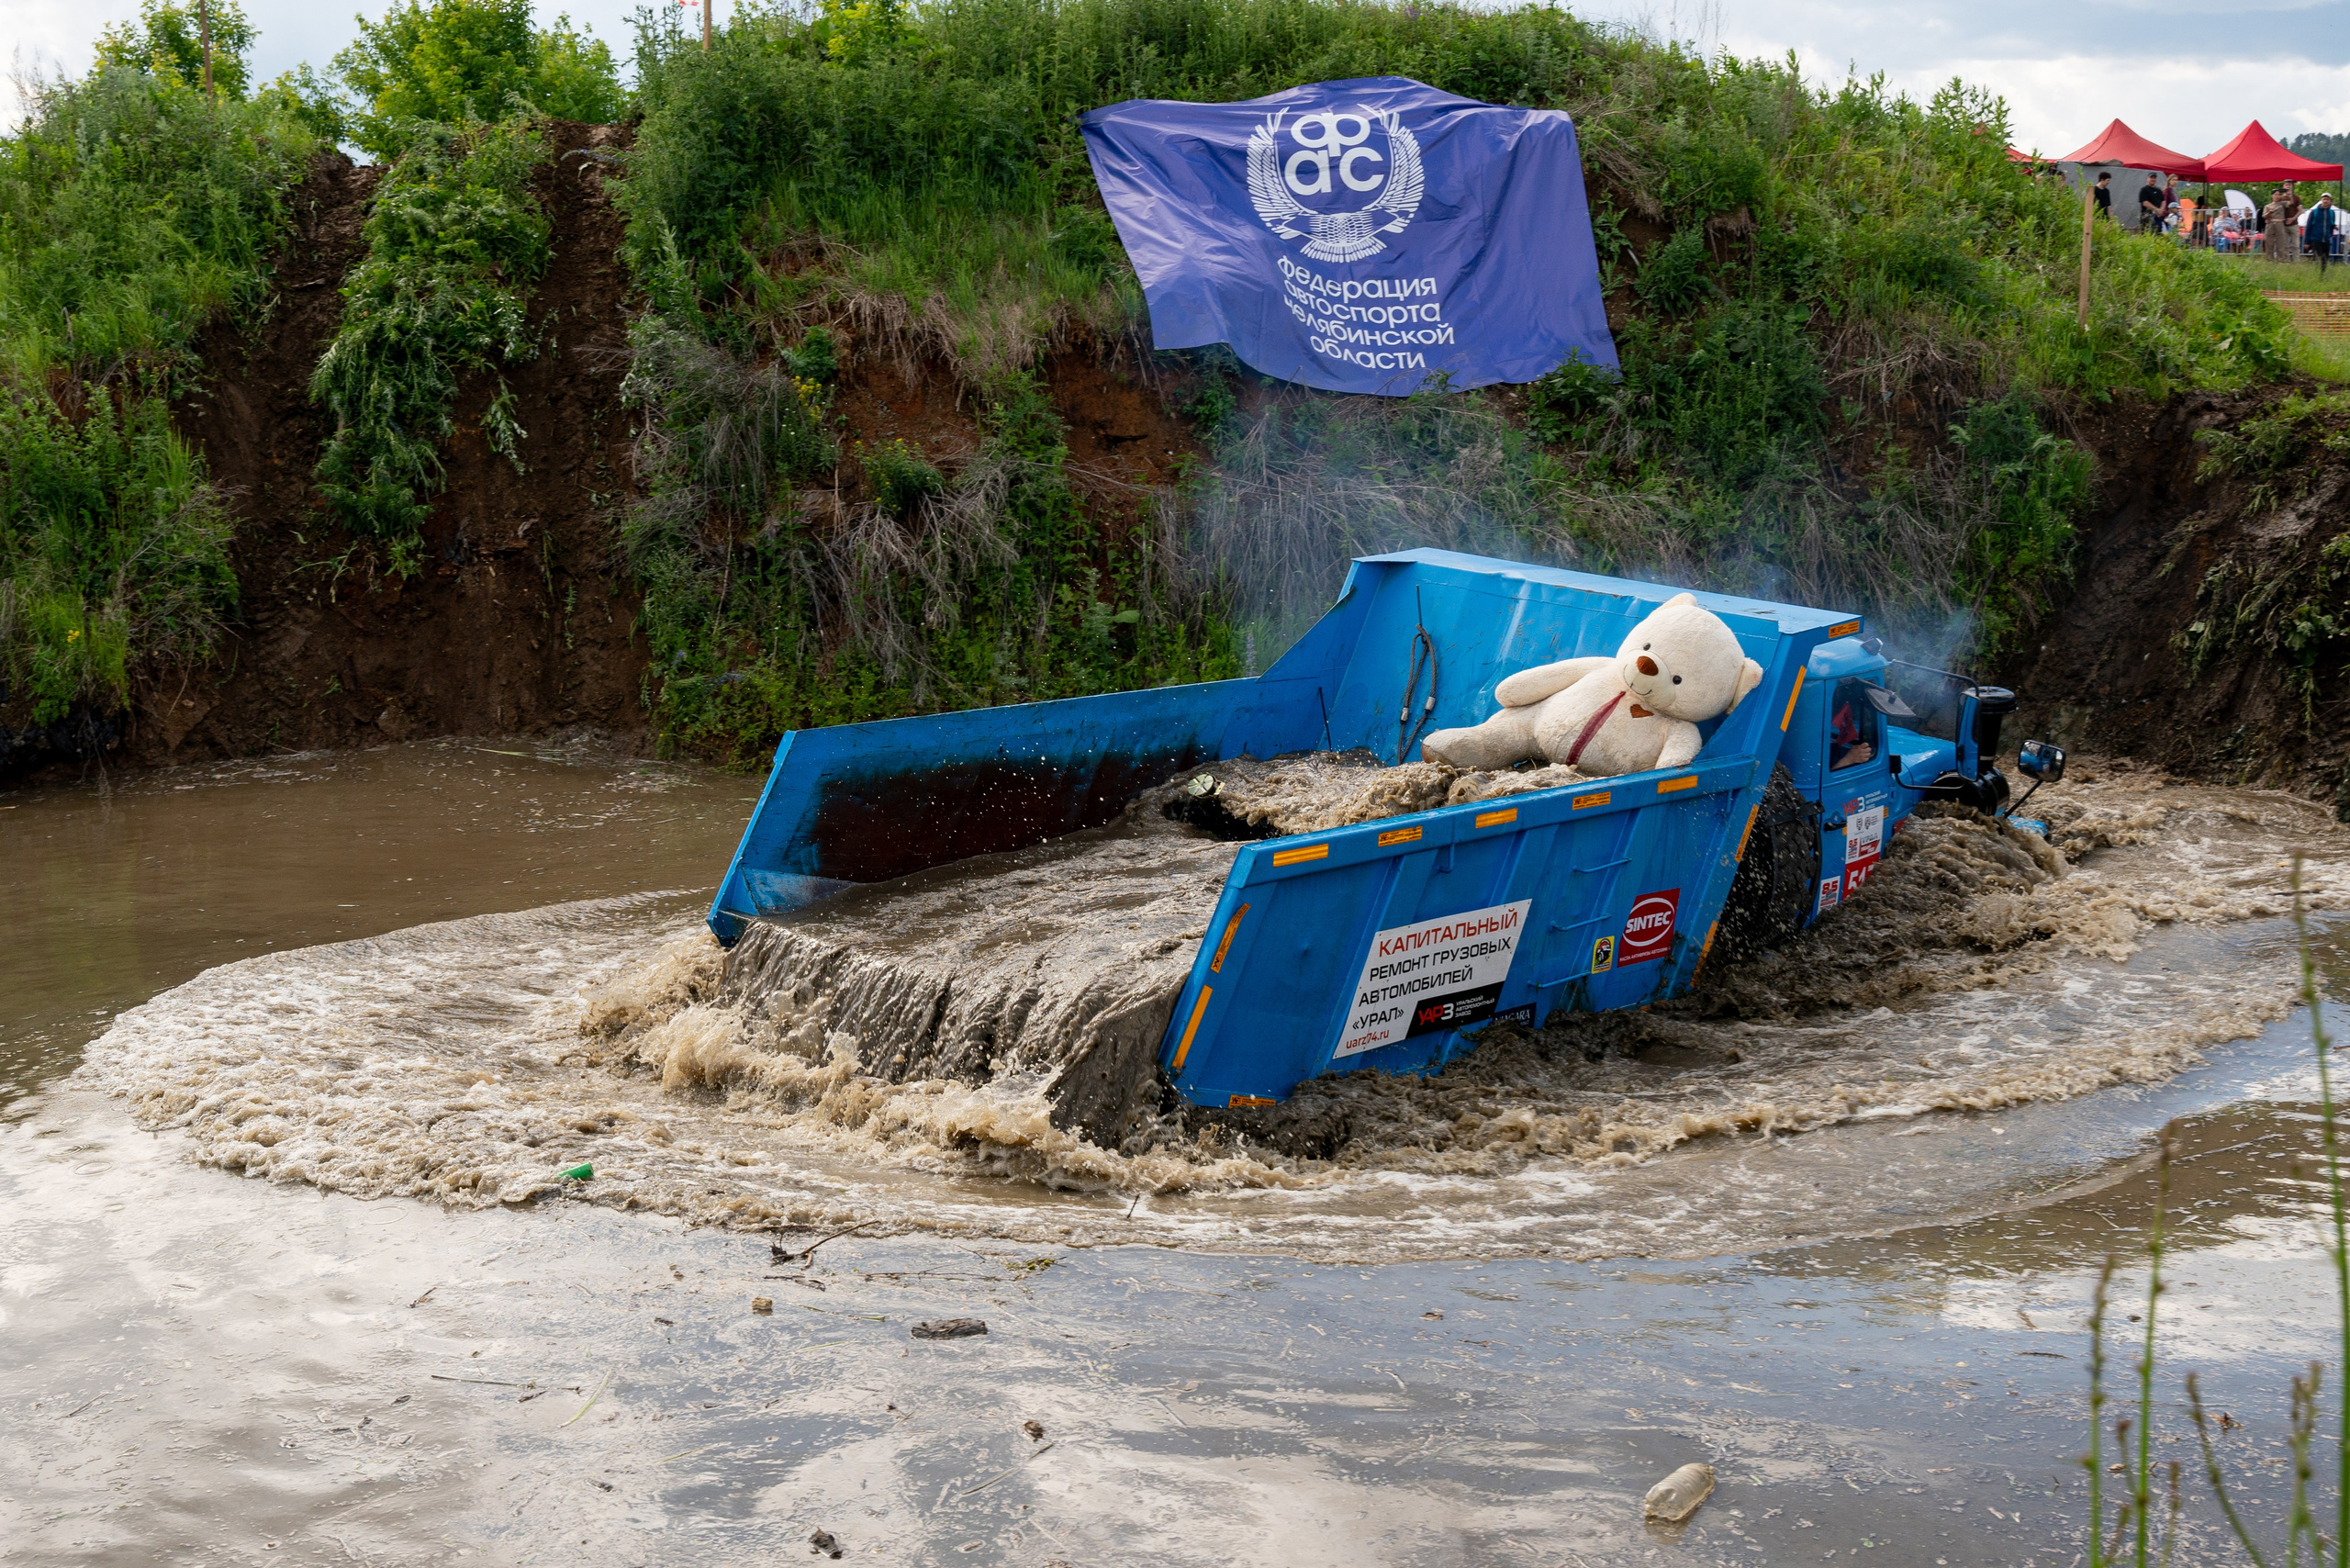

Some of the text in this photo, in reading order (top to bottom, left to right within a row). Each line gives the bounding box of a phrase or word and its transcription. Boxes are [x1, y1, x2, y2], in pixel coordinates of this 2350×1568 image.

[1276, 254, 1438, 304] федерация
[1283, 279, 1441, 329] автоспорта
[1309, 335, 1427, 369] области
[1379, 908, 1518, 958] КАПИТАЛЬНЫЙ
[1625, 911, 1672, 934] SINTEC
[1369, 936, 1512, 981] РЕМОНТ ГРУЗОВЫХ
[1358, 965, 1473, 1007] АВТОМОБИЛЕЙ
[1346, 1029, 1390, 1049] uarz74.ru
[1352, 1006, 1404, 1030] «УРАЛ»
